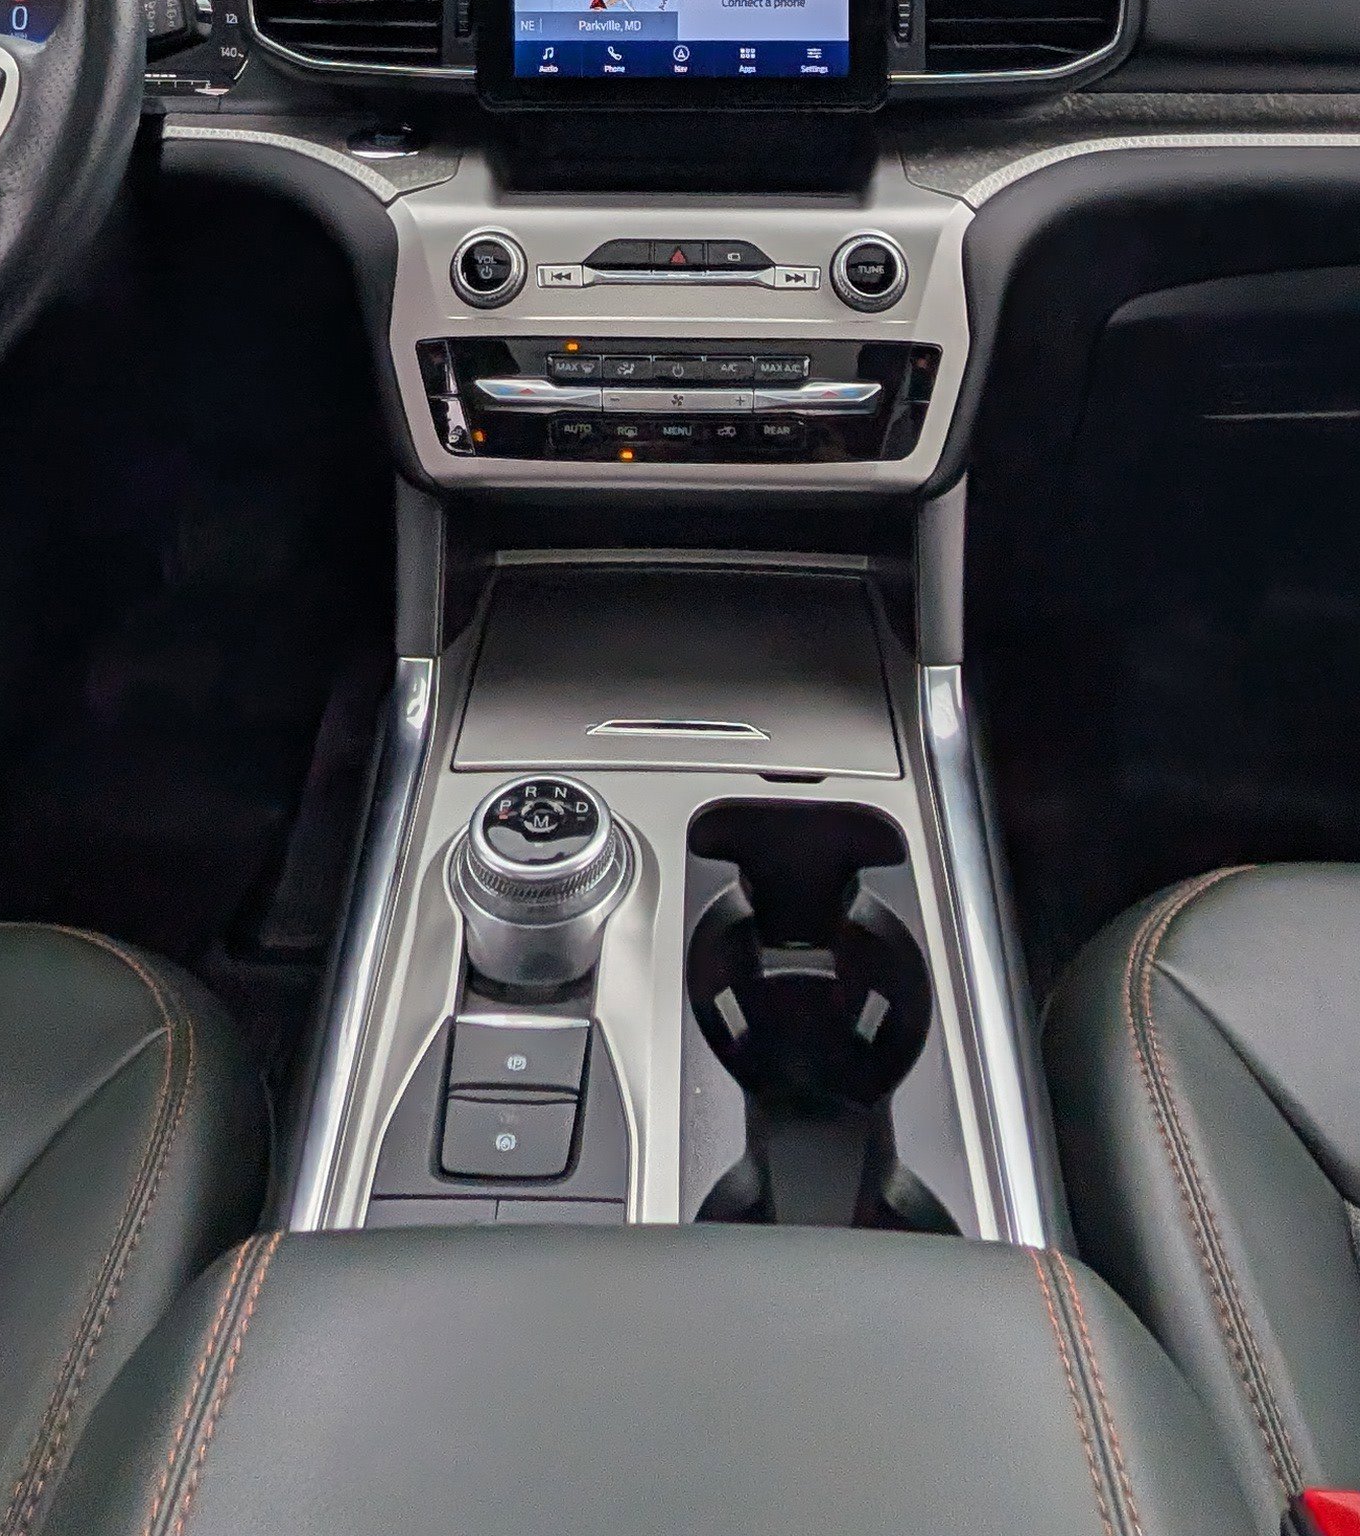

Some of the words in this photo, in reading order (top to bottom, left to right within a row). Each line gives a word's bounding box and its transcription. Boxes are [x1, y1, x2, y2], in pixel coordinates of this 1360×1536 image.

[765, 0, 772, 8] a
[12, 5, 28, 31] 0
[521, 21, 535, 31] NE
[579, 20, 624, 32] Parkville,
[625, 21, 642, 31] MD
[220, 46, 238, 58] 140
[477, 255, 497, 264] VOL
[858, 265, 885, 275] TUNE
[556, 363, 578, 372] MAX
[760, 363, 782, 372] MAX
[563, 423, 592, 434] AUTO
[662, 426, 693, 436] MENU
[763, 425, 790, 435] REAR
[525, 786, 538, 798] R
[554, 787, 568, 799] N
[499, 800, 512, 812] P
[575, 801, 589, 813] D
[533, 815, 550, 828] M
